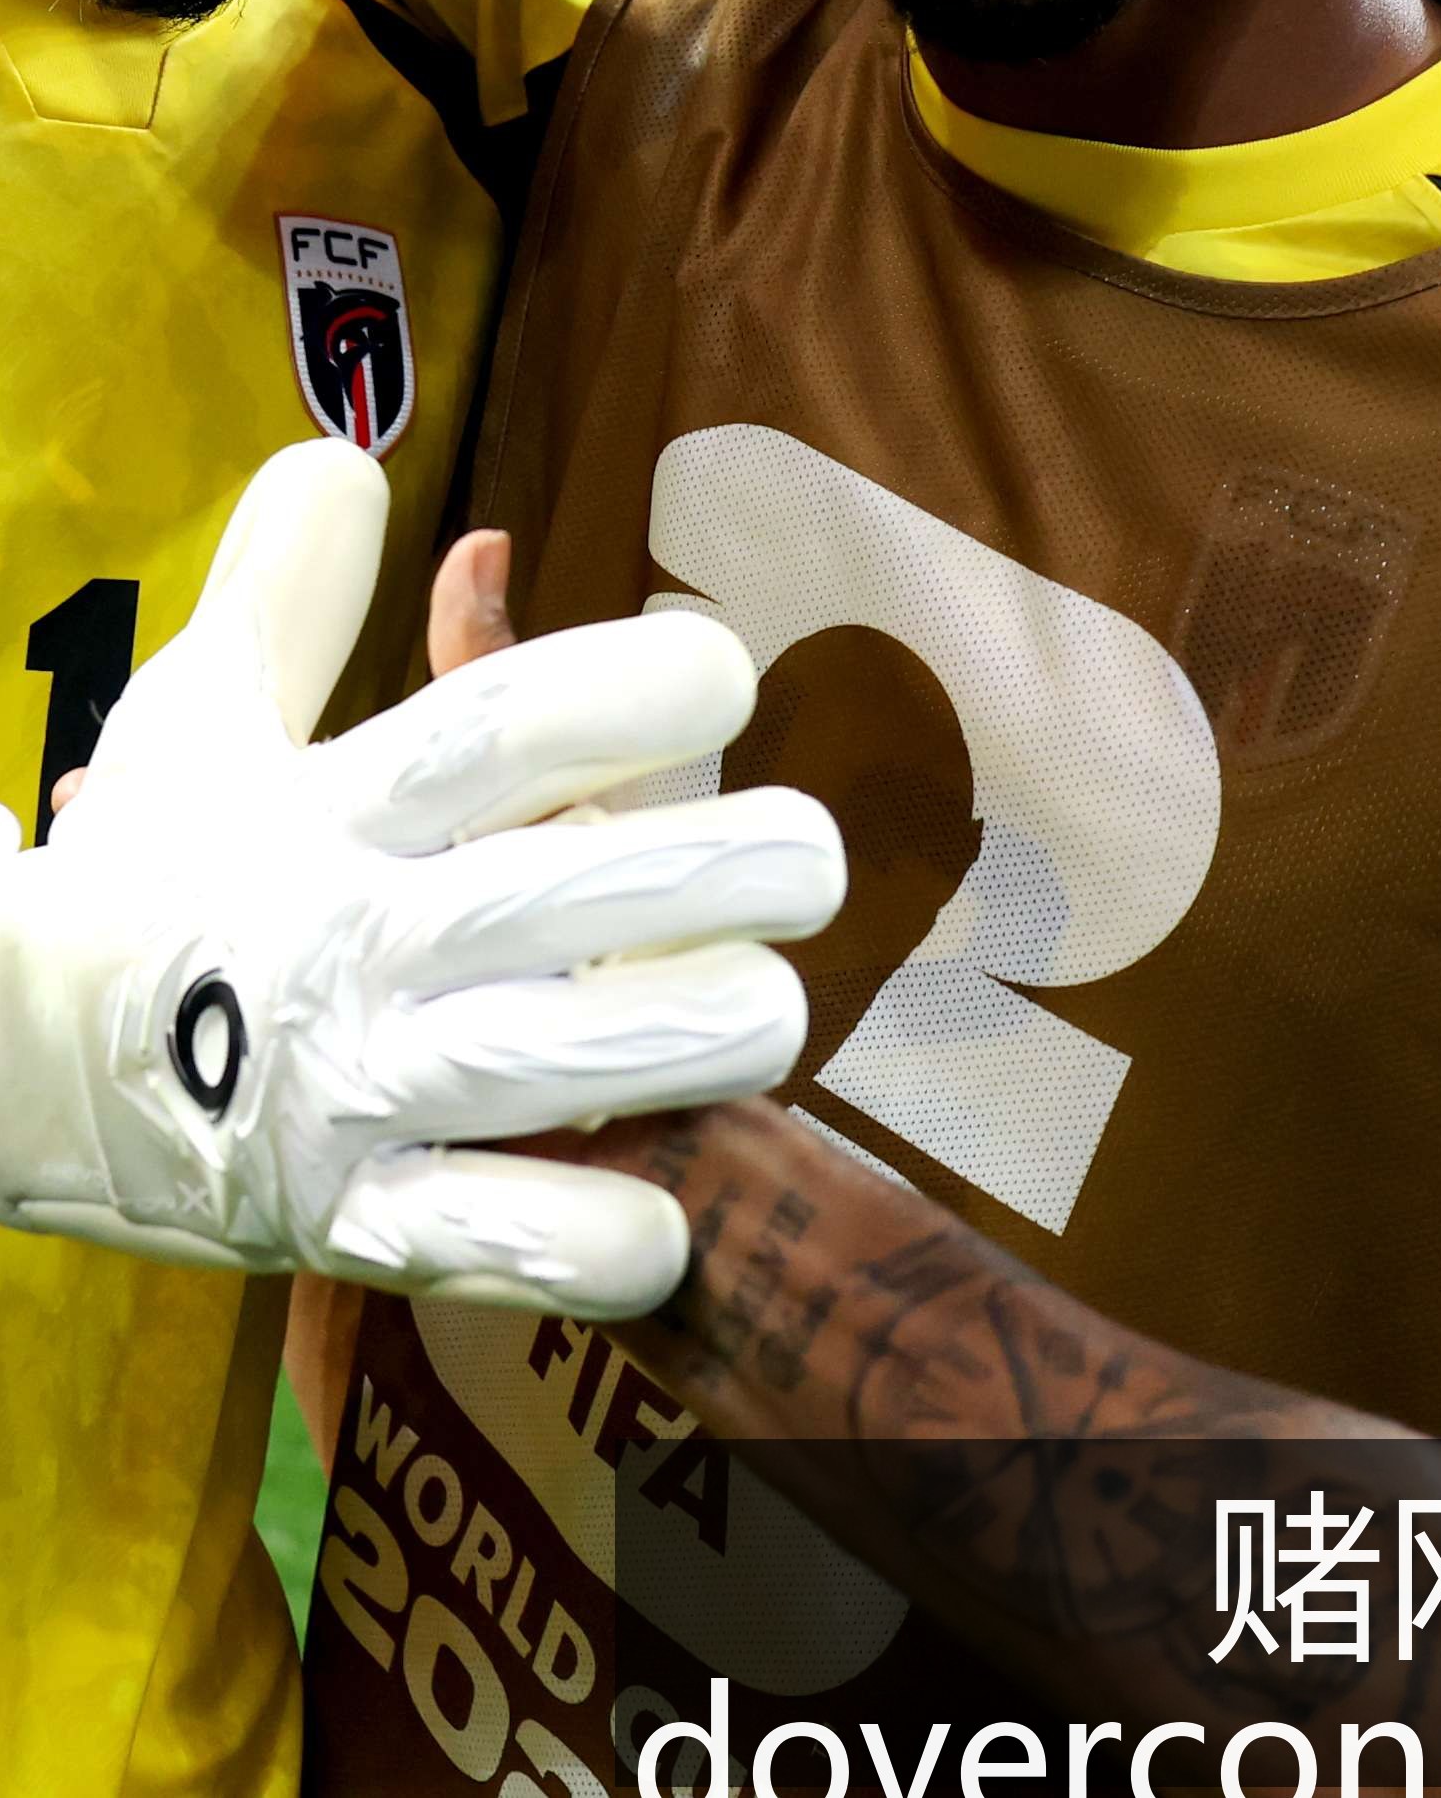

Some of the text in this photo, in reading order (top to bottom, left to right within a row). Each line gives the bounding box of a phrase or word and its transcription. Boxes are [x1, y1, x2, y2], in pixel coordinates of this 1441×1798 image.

[291, 228, 389, 269] FCF
[25, 578, 140, 847] 1
[354, 1374, 596, 1705] WORLD
